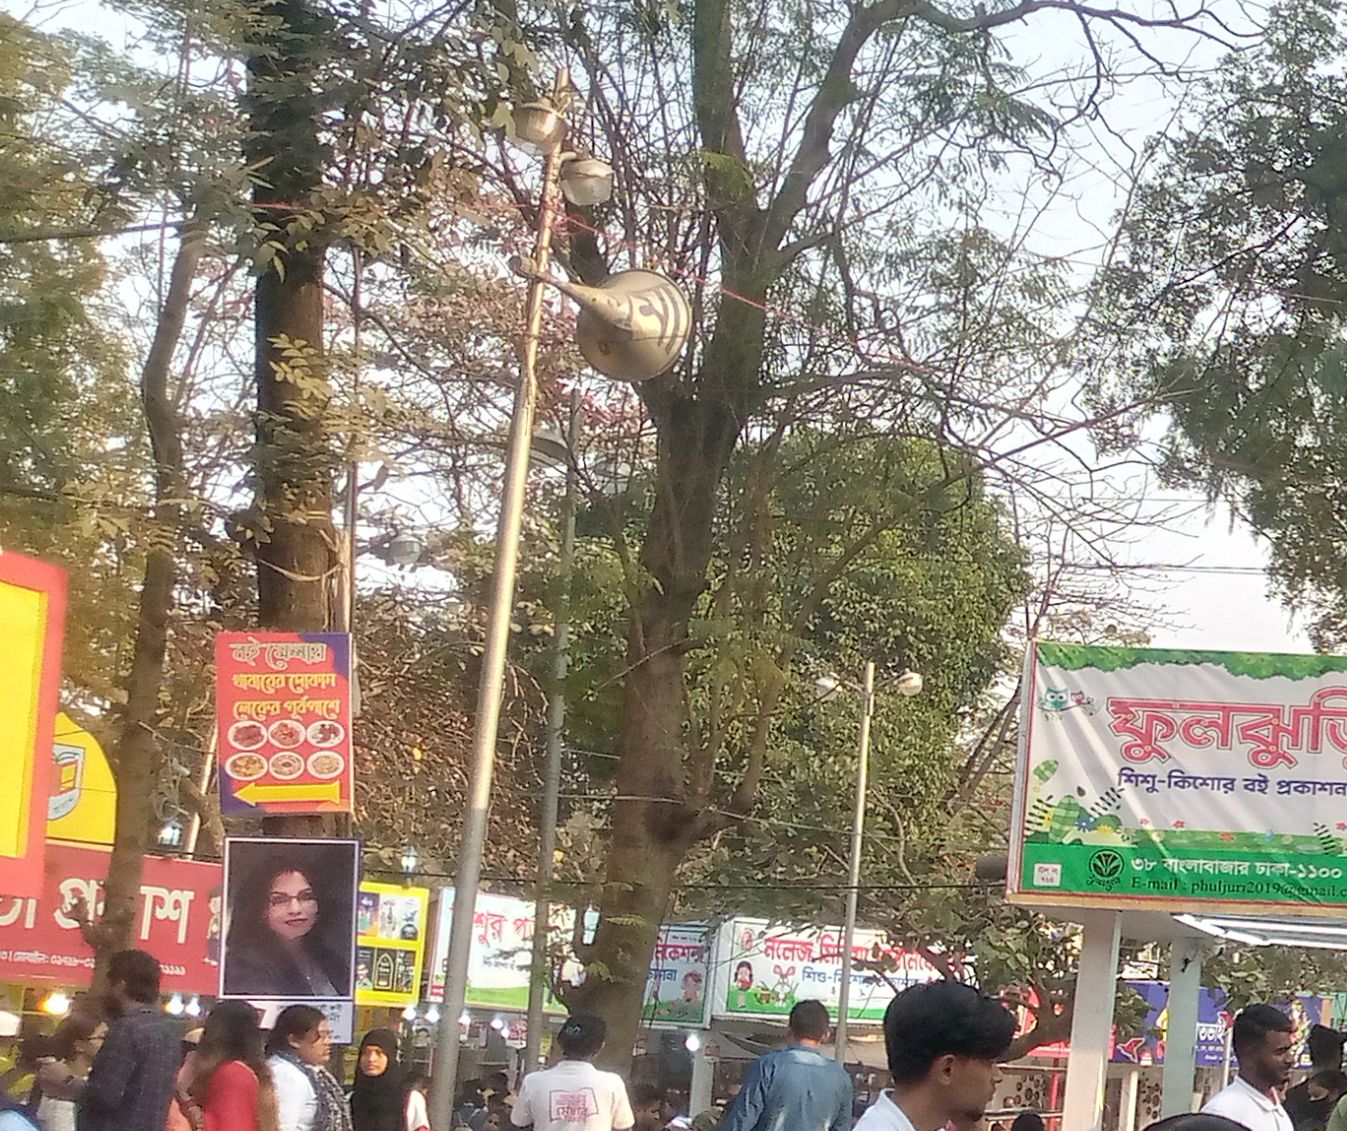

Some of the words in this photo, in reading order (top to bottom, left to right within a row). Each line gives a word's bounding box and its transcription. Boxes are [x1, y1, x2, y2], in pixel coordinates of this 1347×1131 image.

[232, 674, 285, 693] খাবারের
[289, 674, 336, 693] দোকান
[233, 700, 281, 721] লেকের
[1119, 767, 1236, 795] শিশু-কিশোর
[1243, 773, 1269, 795] বই
[1131, 858, 1157, 873] ৩৮
[1163, 857, 1250, 877] বাংলাবাজার
[1254, 860, 1343, 880] ঢাকা-১১০০
[1131, 878, 1178, 891] E-mail
[53, 878, 195, 944] প্রাশ
